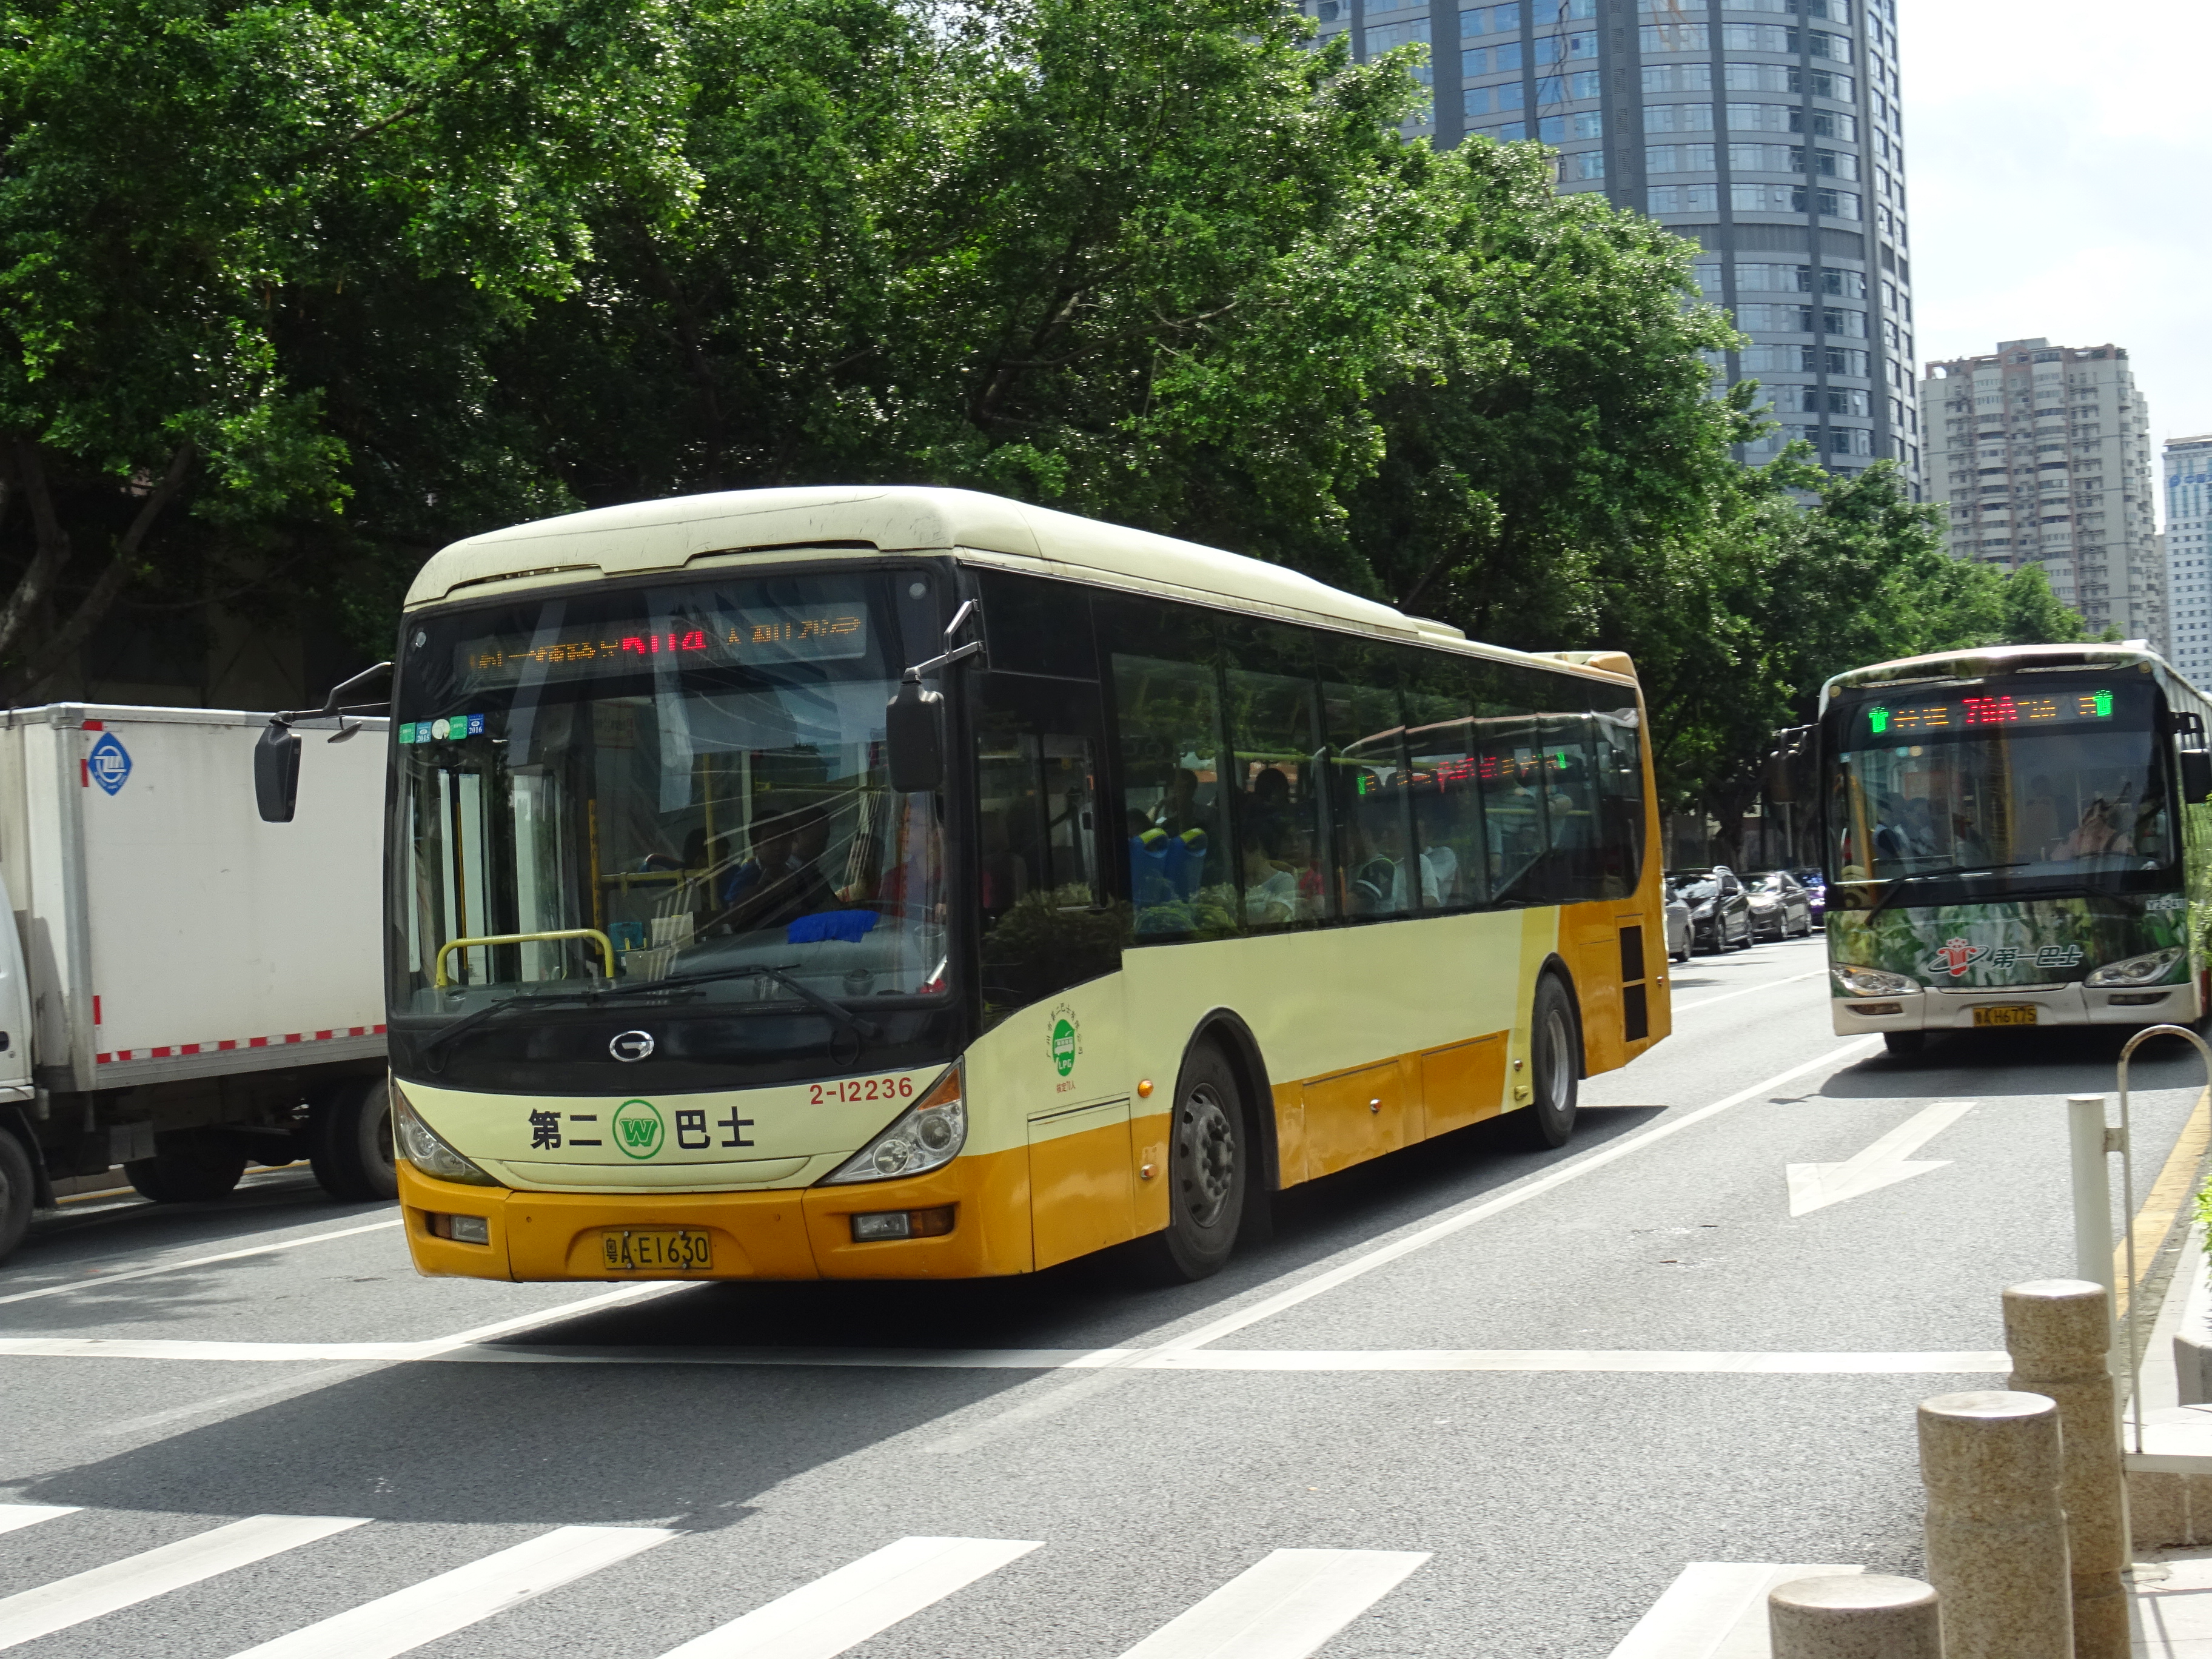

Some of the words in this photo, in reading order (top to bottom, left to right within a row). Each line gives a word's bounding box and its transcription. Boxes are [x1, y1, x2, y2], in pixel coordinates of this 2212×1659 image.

[1992, 945, 2083, 969] 第一巴士
[1059, 1059, 1072, 1070] LPG
[809, 1077, 913, 1105] 2-12236
[528, 1108, 602, 1150] 第二
[675, 1106, 755, 1149] 巴士
